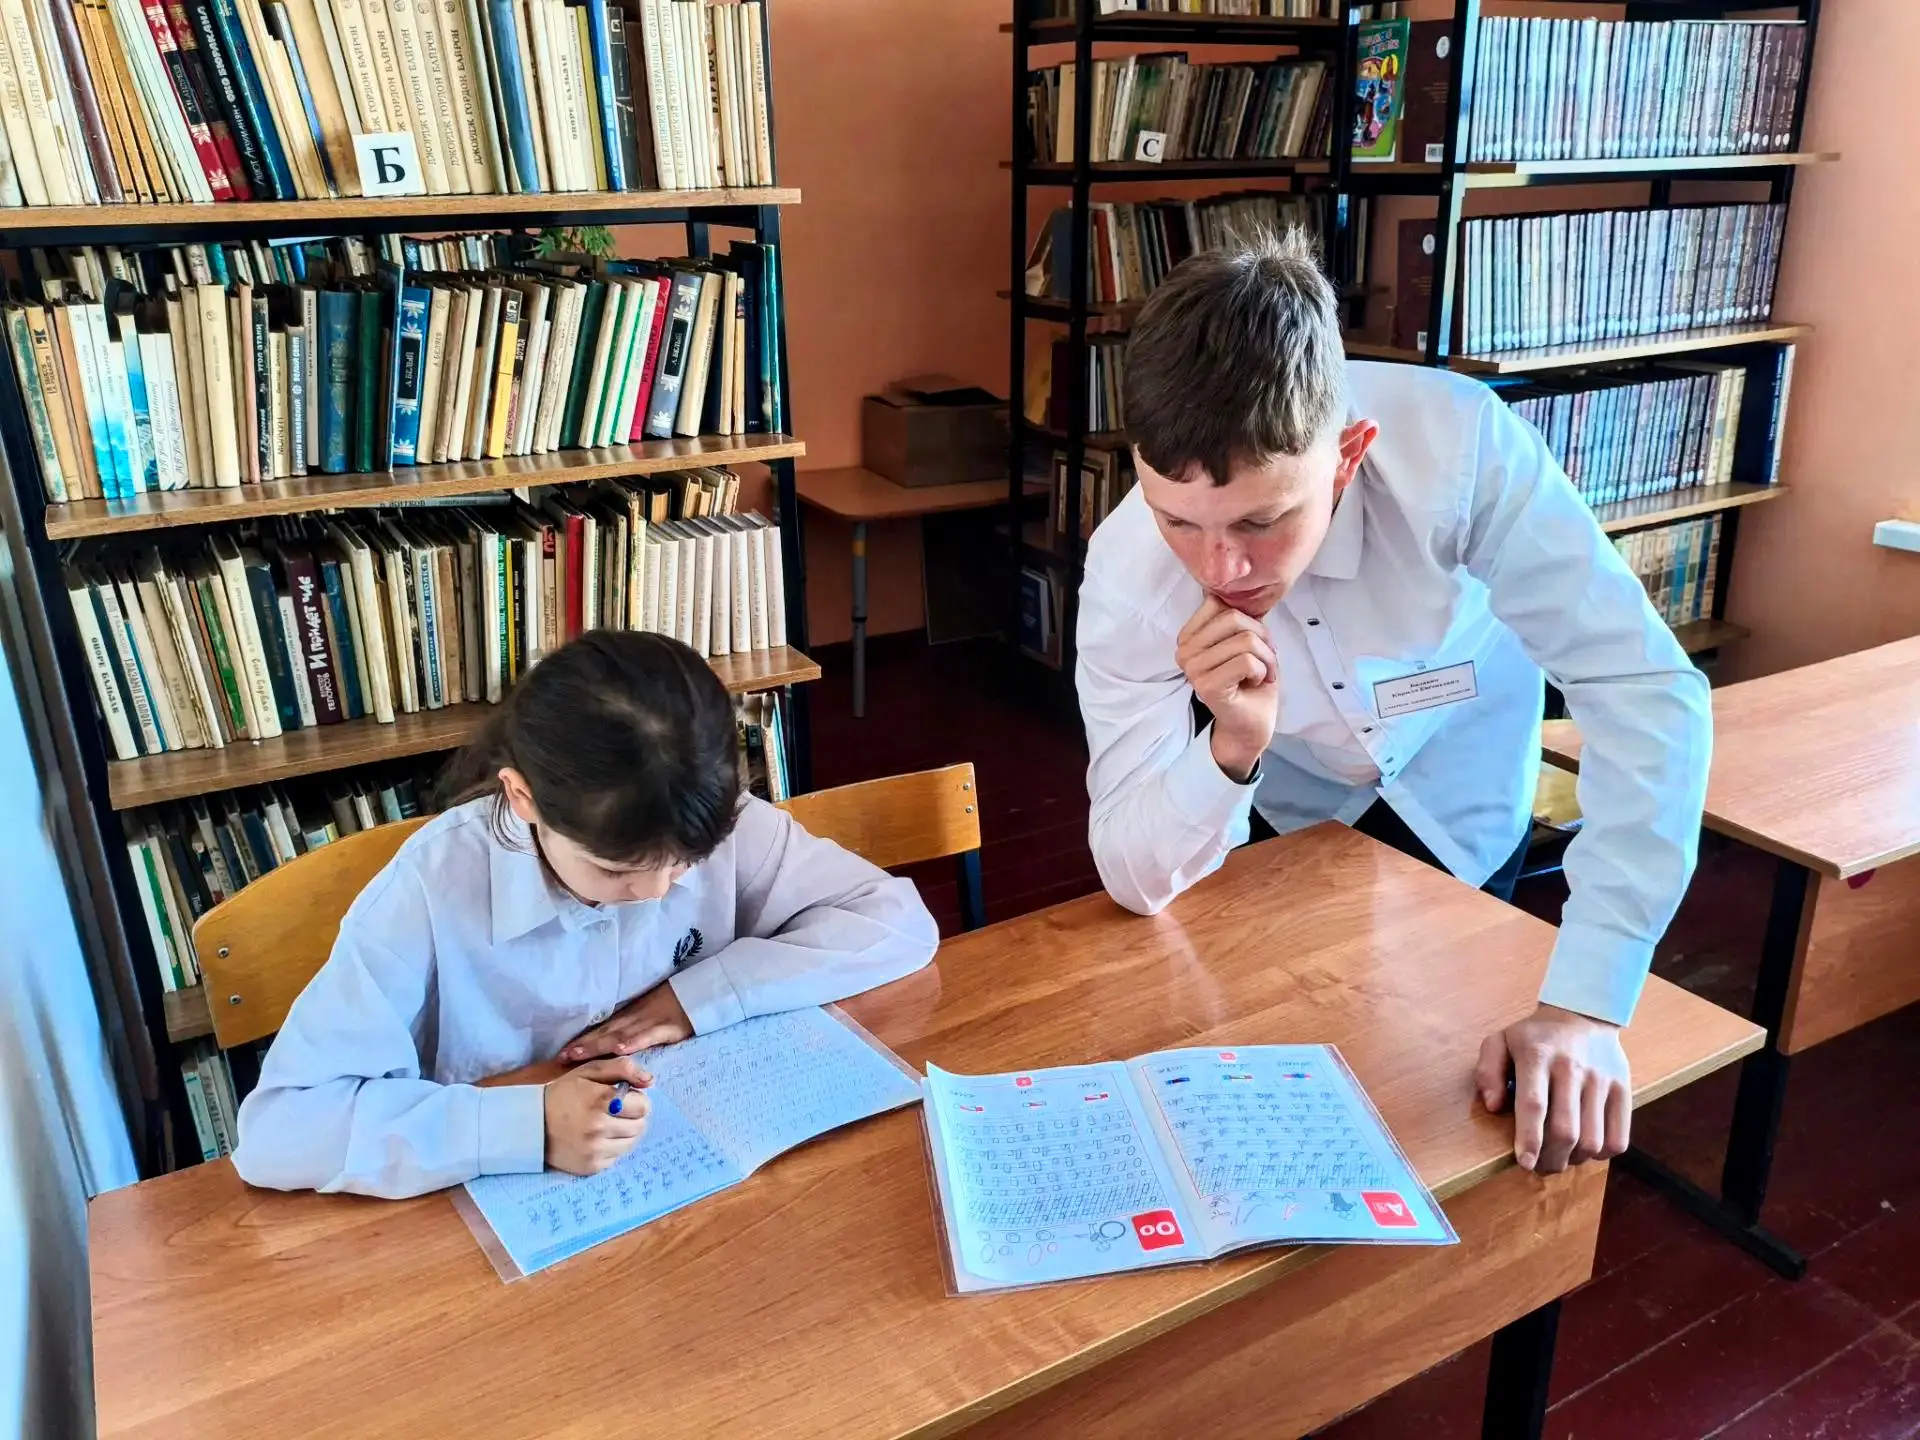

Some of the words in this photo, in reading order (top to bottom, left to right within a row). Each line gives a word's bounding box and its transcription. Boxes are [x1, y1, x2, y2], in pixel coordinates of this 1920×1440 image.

[197, 5, 226, 76] БЮРАКАНА
[349, 25, 365, 68] БАЙРОН
[376, 30, 393, 72] БАЙРОН
[401, 28, 416, 71] БАЙРОН
[425, 31, 440, 72] БАЙРОН
[451, 29, 465, 71] БАЙРОН
[221, 77, 235, 102] ОКО
[362, 72, 378, 113] ГОРДОН
[388, 77, 402, 117] ГОРДОН
[411, 76, 426, 116] ГОРДОН
[435, 77, 449, 117] ГОРДОН
[459, 75, 472, 115] ГОРДОН
[420, 119, 436, 165] ДЖОРДЖ
[444, 120, 460, 166] ДЖОРДЖ
[467, 119, 483, 165] ДЖОРДЖ
[1143, 138, 1160, 158] С
[369, 147, 406, 184] Б
[308, 653, 328, 669] И
[103, 672, 120, 714] БАЛЬЗАК
